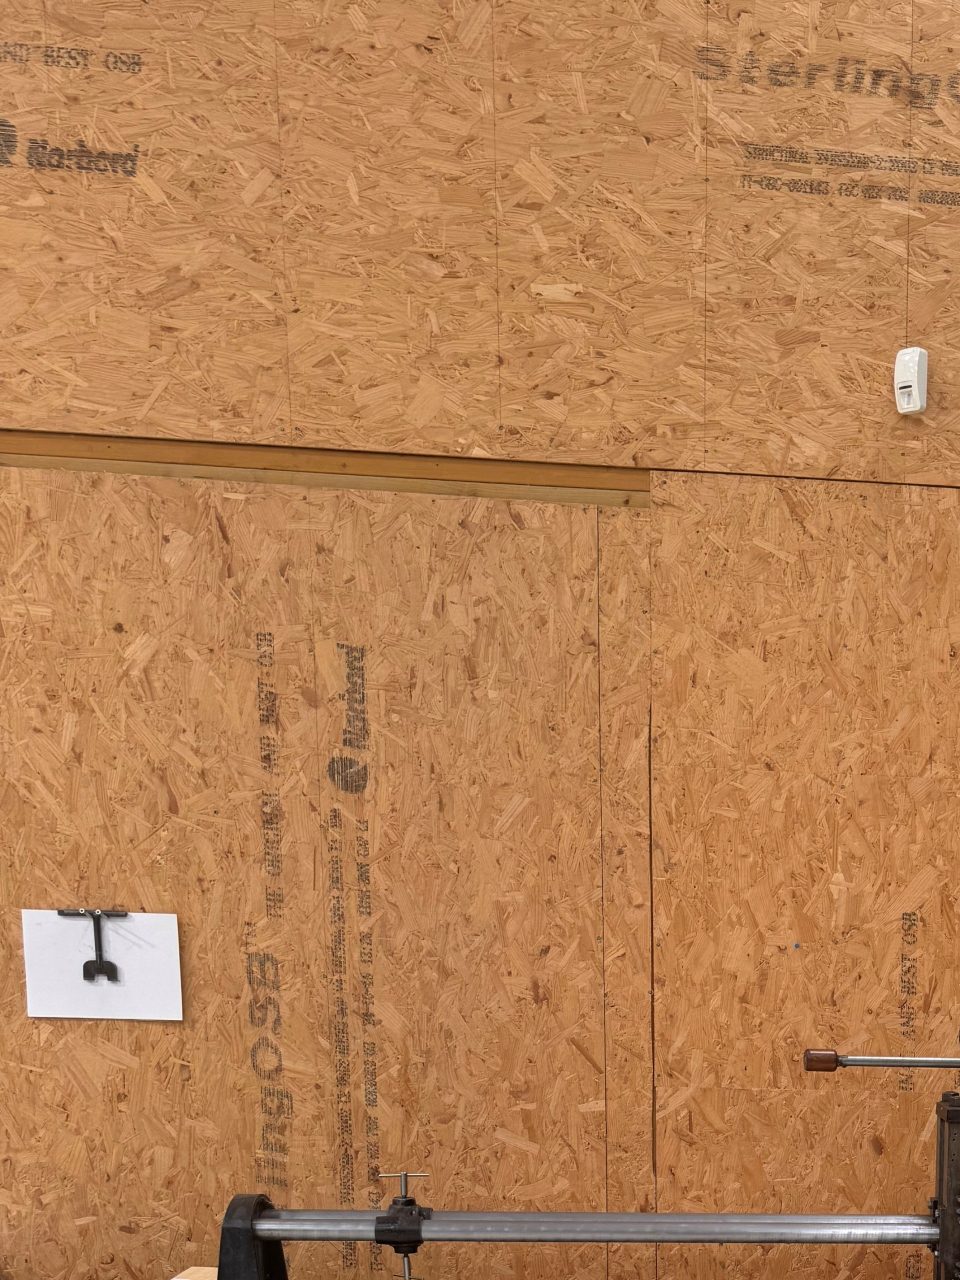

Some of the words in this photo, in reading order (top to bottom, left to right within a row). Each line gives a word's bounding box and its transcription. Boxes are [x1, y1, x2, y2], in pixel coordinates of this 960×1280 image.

[44, 45, 89, 69] BEST
[105, 51, 142, 75] OSB
[27, 137, 140, 178] Norbord
[336, 642, 370, 751] Norbord
[901, 911, 918, 945] OSB
[900, 953, 918, 997] BEST
